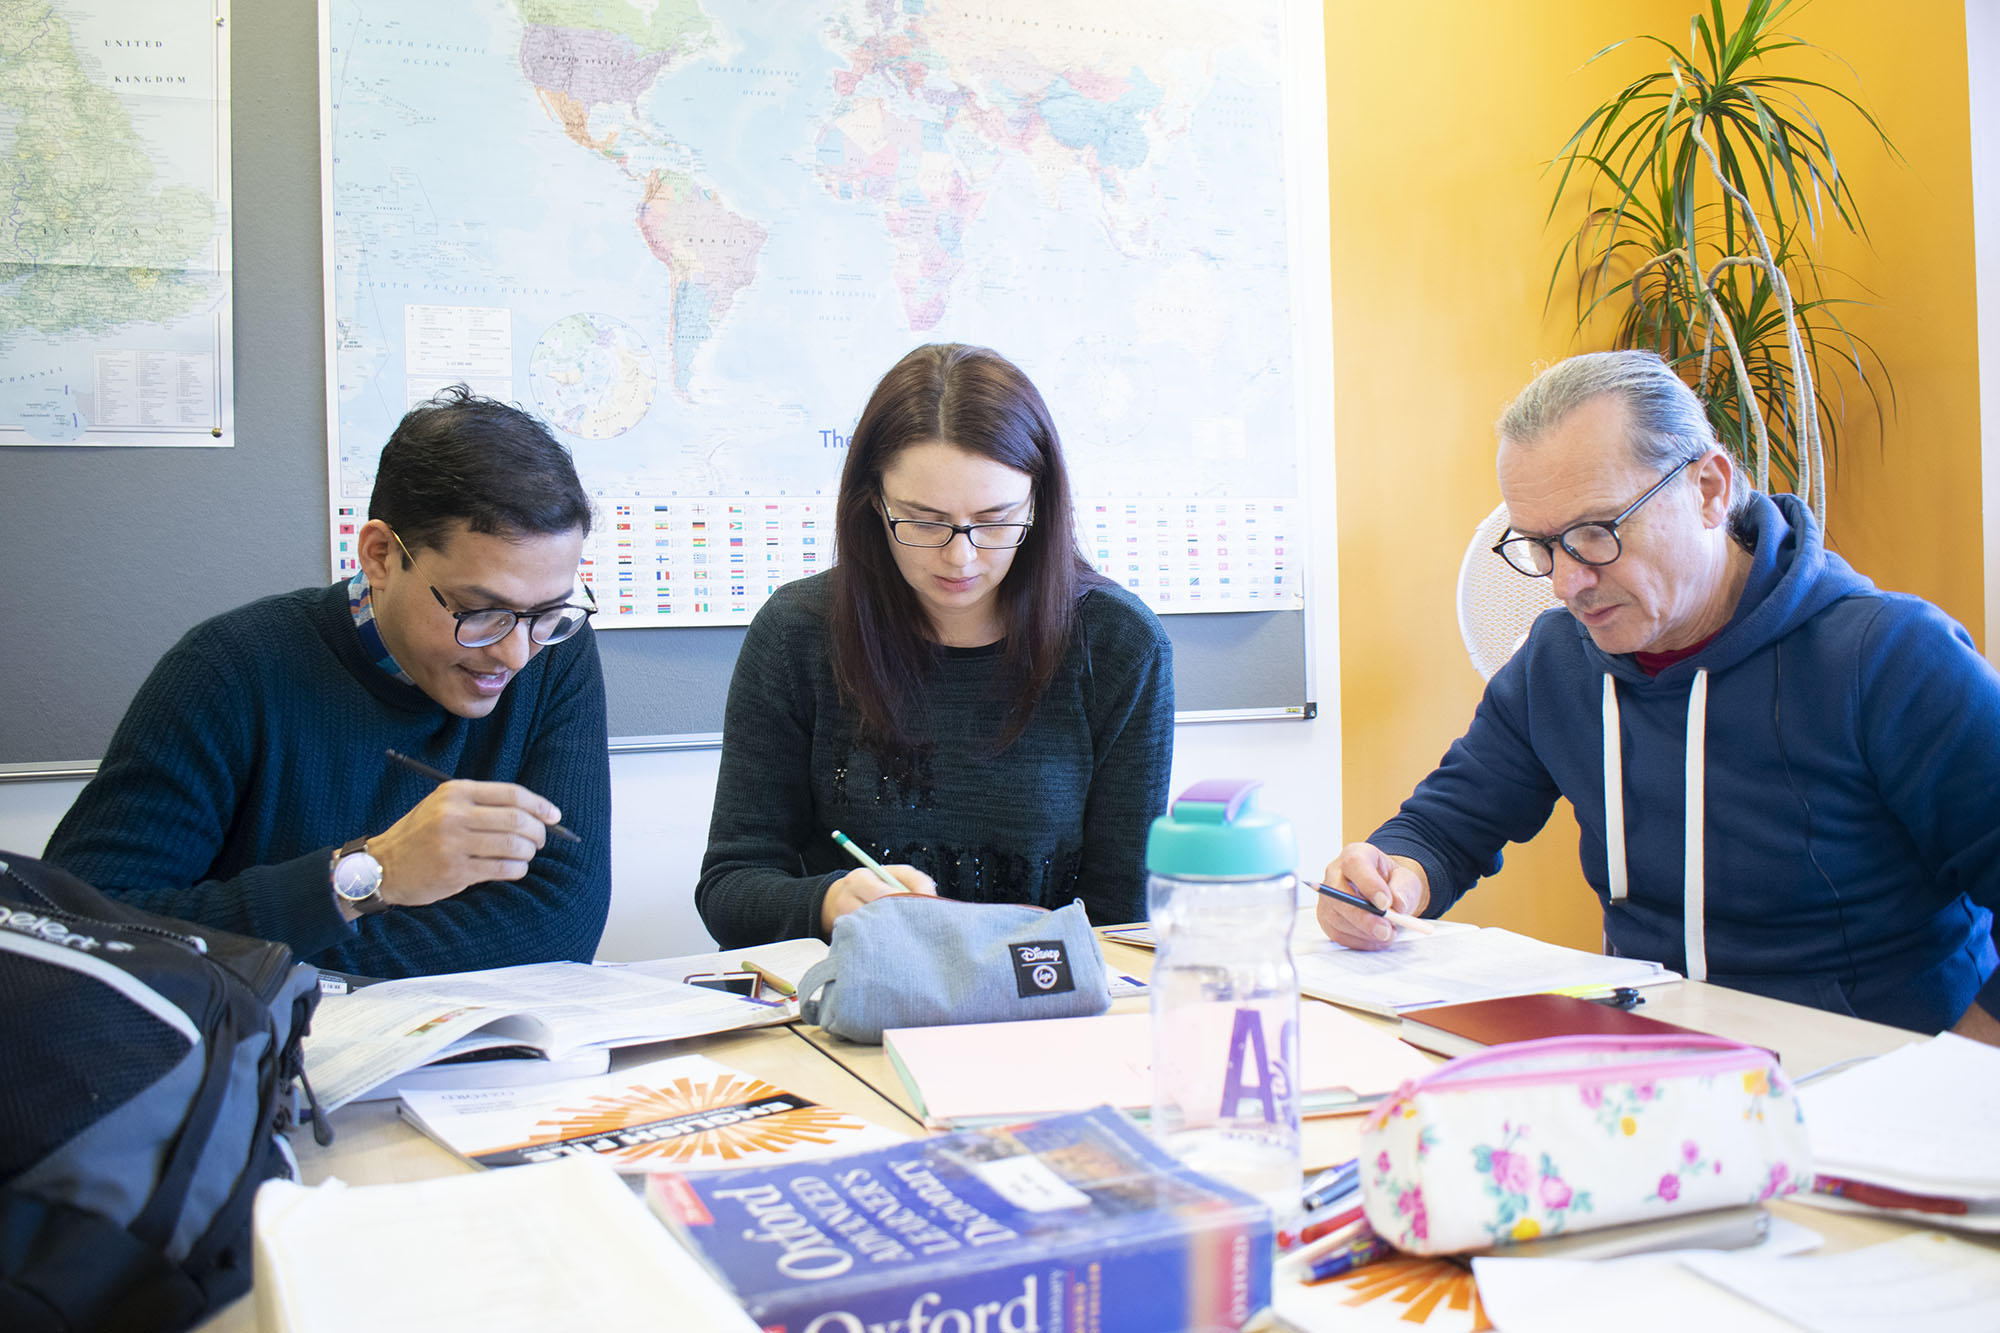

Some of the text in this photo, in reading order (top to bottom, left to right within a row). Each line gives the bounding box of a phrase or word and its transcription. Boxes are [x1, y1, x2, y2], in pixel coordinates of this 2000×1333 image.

[104, 39, 163, 48] UNITED
[403, 57, 451, 67] OCEAN
[114, 75, 187, 84] KINGDOM
[1017, 946, 1061, 962] Disney
[618, 1101, 795, 1147] ENGLISH
[716, 1183, 854, 1280] Oxford
